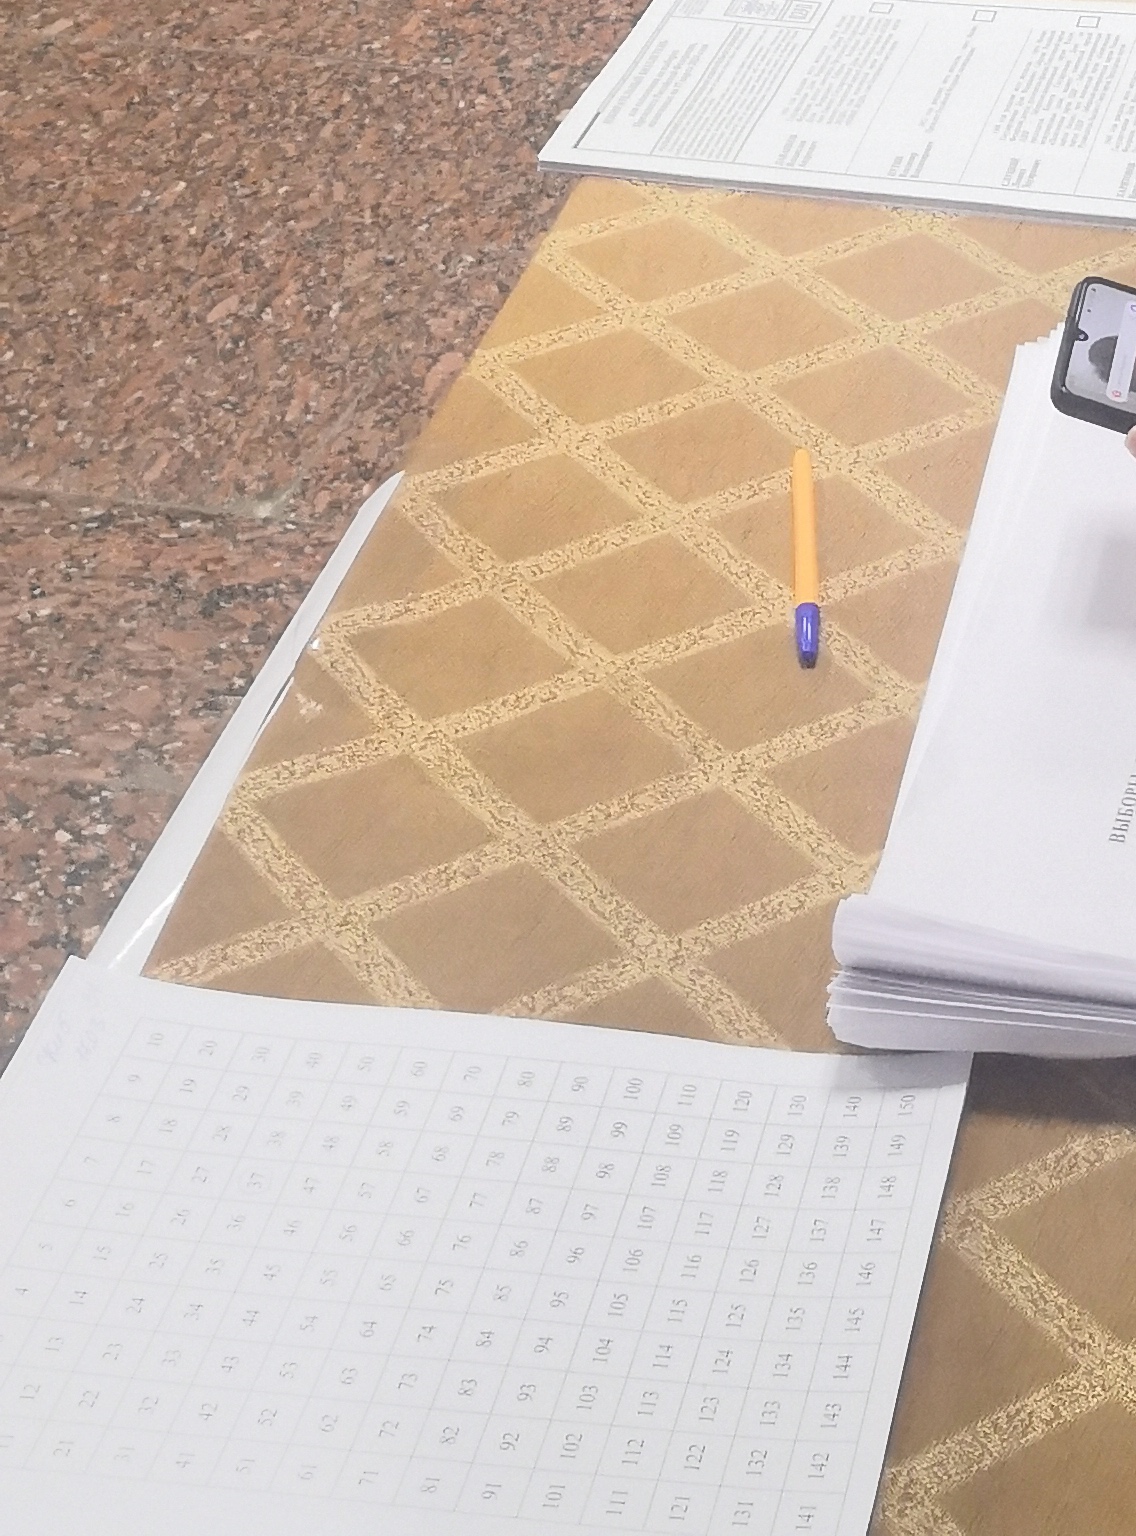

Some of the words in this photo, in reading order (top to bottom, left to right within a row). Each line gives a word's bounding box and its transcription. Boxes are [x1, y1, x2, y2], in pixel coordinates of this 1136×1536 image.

[876, 1175, 898, 1199] 148
[886, 1133, 907, 1157] 149
[897, 1094, 917, 1117] 150
[174, 1452, 196, 1470] 41
[197, 1402, 219, 1422] 42
[220, 1355, 240, 1374] 43
[241, 1309, 261, 1327] 44
[262, 1264, 282, 1282] 45
[282, 1219, 302, 1237] 46
[302, 1176, 322, 1195] 47
[321, 1135, 341, 1153] 48
[339, 1094, 358, 1112] 49
[356, 1055, 376, 1073] 50
[234, 1457, 256, 1475] 51
[256, 1407, 279, 1427] 52
[278, 1361, 299, 1380] 53
[298, 1314, 319, 1333] 54
[318, 1268, 339, 1287] 55
[337, 1224, 358, 1243] 56
[356, 1181, 376, 1200] 57
[375, 1140, 394, 1158] 58
[392, 1099, 411, 1117] 59
[409, 1060, 428, 1078] 60
[296, 1464, 318, 1482] 61
[318, 1413, 340, 1434] 62
[339, 1367, 359, 1386] 63
[358, 1320, 379, 1339] 64
[378, 1273, 397, 1292] 65
[396, 1229, 415, 1247] 66
[414, 1186, 431, 1205] 67
[430, 1145, 450, 1163] 68
[447, 1105, 465, 1123] 69
[462, 1065, 483, 1082] 70
[357, 1469, 380, 1487] 71
[377, 1419, 401, 1438] 72
[396, 1372, 419, 1391] 73
[416, 1324, 437, 1343] 74
[433, 1279, 455, 1296] 75
[451, 1234, 473, 1252] 76
[468, 1191, 488, 1209] 77
[484, 1150, 506, 1168] 78
[500, 1110, 521, 1127] 79
[516, 1070, 536, 1088] 80
[419, 1476, 442, 1495] 81
[438, 1425, 461, 1446] 82
[457, 1378, 478, 1398] 83
[474, 1330, 496, 1348] 84
[492, 1284, 512, 1302] 85
[508, 1239, 529, 1258] 86
[524, 1197, 544, 1216] 87
[541, 1156, 561, 1174] 88
[555, 1115, 574, 1133] 89
[570, 1075, 590, 1093] 90
[481, 1482, 503, 1500] 91
[498, 1432, 521, 1451] 92
[516, 1383, 537, 1402] 93
[533, 1336, 554, 1354] 94
[549, 1290, 570, 1309] 95
[565, 1246, 585, 1264] 96
[580, 1203, 599, 1222] 97
[595, 1163, 615, 1180] 98
[610, 1121, 629, 1139] 99
[622, 1077, 644, 1101] 100
[541, 1484, 567, 1509] 101
[559, 1433, 584, 1460] 102
[575, 1384, 600, 1411] 103
[591, 1337, 615, 1363] 104
[607, 1292, 630, 1318] 105
[622, 1248, 645, 1273] 106
[636, 1205, 657, 1230] 107
[650, 1164, 673, 1188] 108
[664, 1123, 685, 1147] 109
[676, 1083, 698, 1107] 110
[605, 1489, 629, 1516] 111
[620, 1438, 646, 1466] 112
[636, 1390, 660, 1417] 113
[651, 1343, 675, 1369] 114
[666, 1298, 689, 1323] 115
[679, 1254, 703, 1279] 116
[694, 1210, 714, 1236] 117
[706, 1169, 729, 1193] 118
[719, 1128, 741, 1152] 119
[732, 1089, 754, 1113] 120
[668, 1495, 692, 1521] 121
[683, 1444, 707, 1471] 122
[697, 1396, 720, 1422] 123
[711, 1349, 734, 1374] 124
[724, 1303, 747, 1328] 125
[738, 1258, 760, 1283] 126
[751, 1215, 771, 1240] 127
[763, 1174, 785, 1198] 128
[775, 1133, 796, 1156] 129
[786, 1094, 807, 1117] 130
[731, 1501, 755, 1527] 131
[745, 1449, 769, 1476] 132
[758, 1400, 782, 1426] 133
[772, 1352, 794, 1378] 134
[784, 1306, 807, 1331] 135
[796, 1261, 819, 1286] 136
[809, 1218, 827, 1243] 137
[820, 1176, 842, 1200] 138
[832, 1135, 851, 1158] 139
[842, 1094, 862, 1118] 140
[844, 1307, 866, 1333] 145
[855, 1261, 877, 1287] 146
[865, 1218, 886, 1242] 147
[807, 1452, 831, 1479] 142
[819, 1402, 843, 1429] 143
[832, 1354, 854, 1380] 144
[794, 1505, 818, 1530] 141
